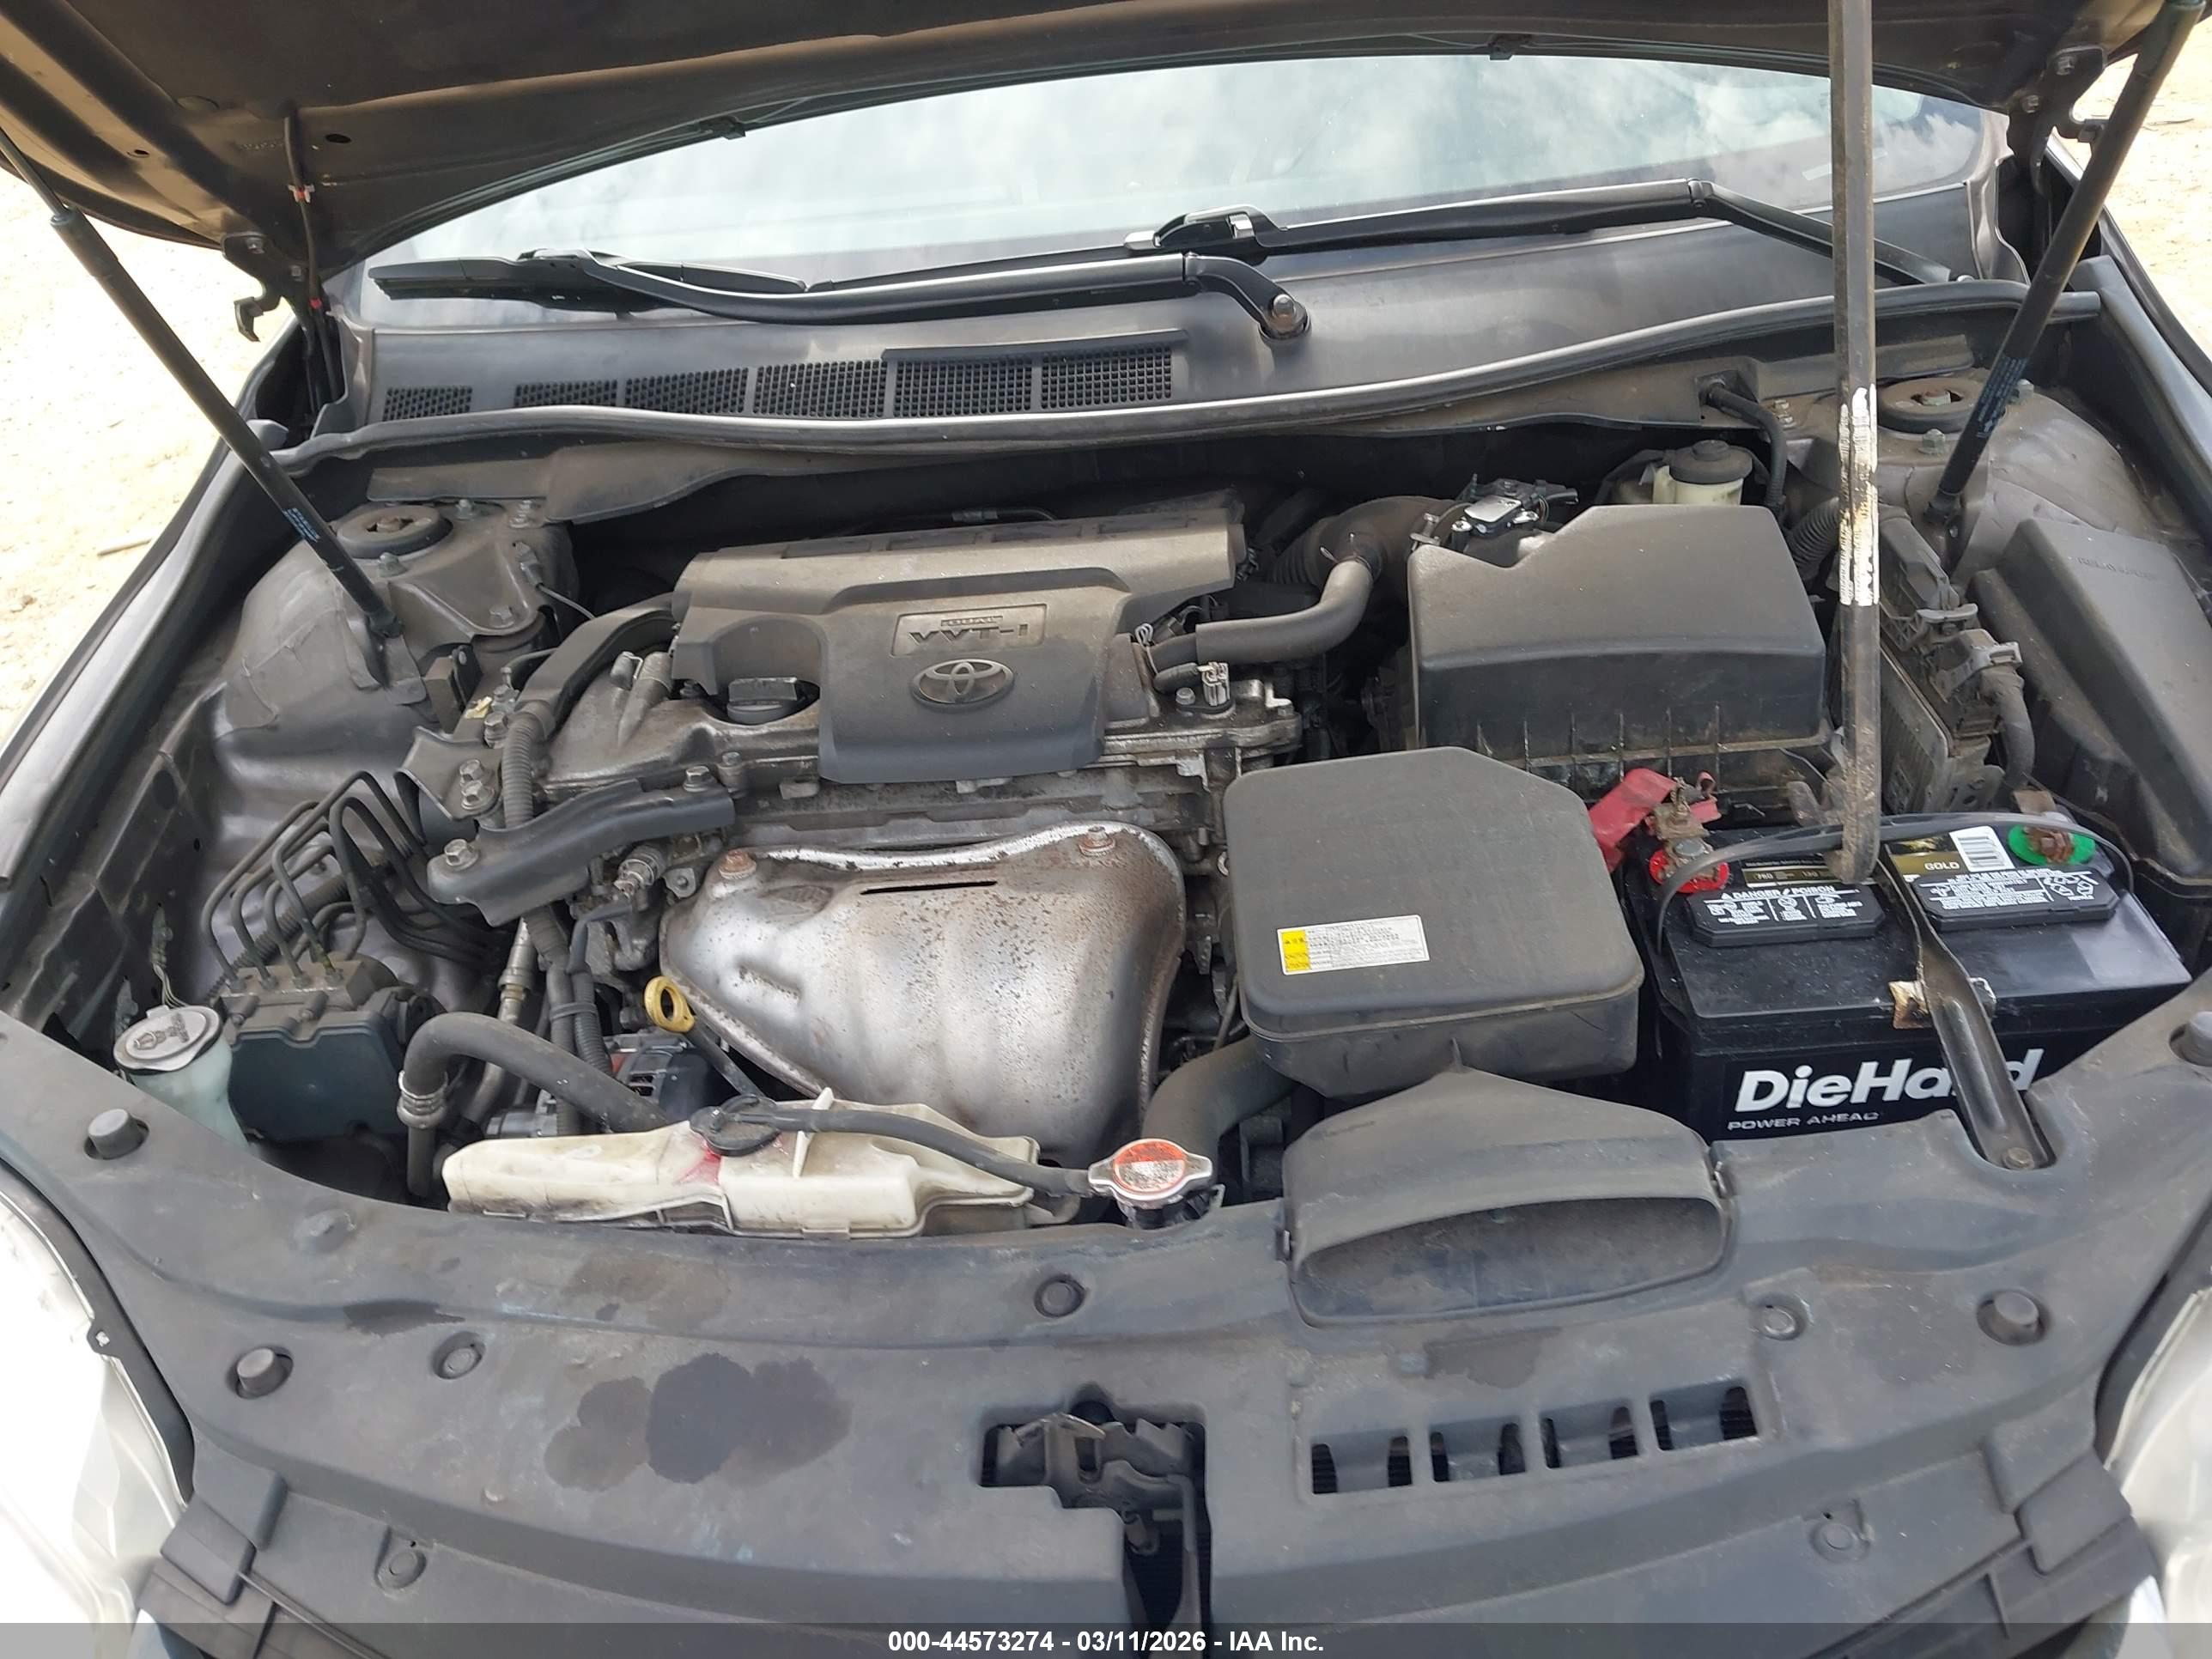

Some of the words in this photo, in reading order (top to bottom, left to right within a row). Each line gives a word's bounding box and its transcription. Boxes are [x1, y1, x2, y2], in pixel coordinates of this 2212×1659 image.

[1924, 861, 1960, 871] GOLD
[1734, 889, 1781, 900] DANGER
[1793, 884, 1836, 895] POISON
[1735, 1048, 2045, 1113] DieHad
[1728, 1118, 1802, 1131] POWER
